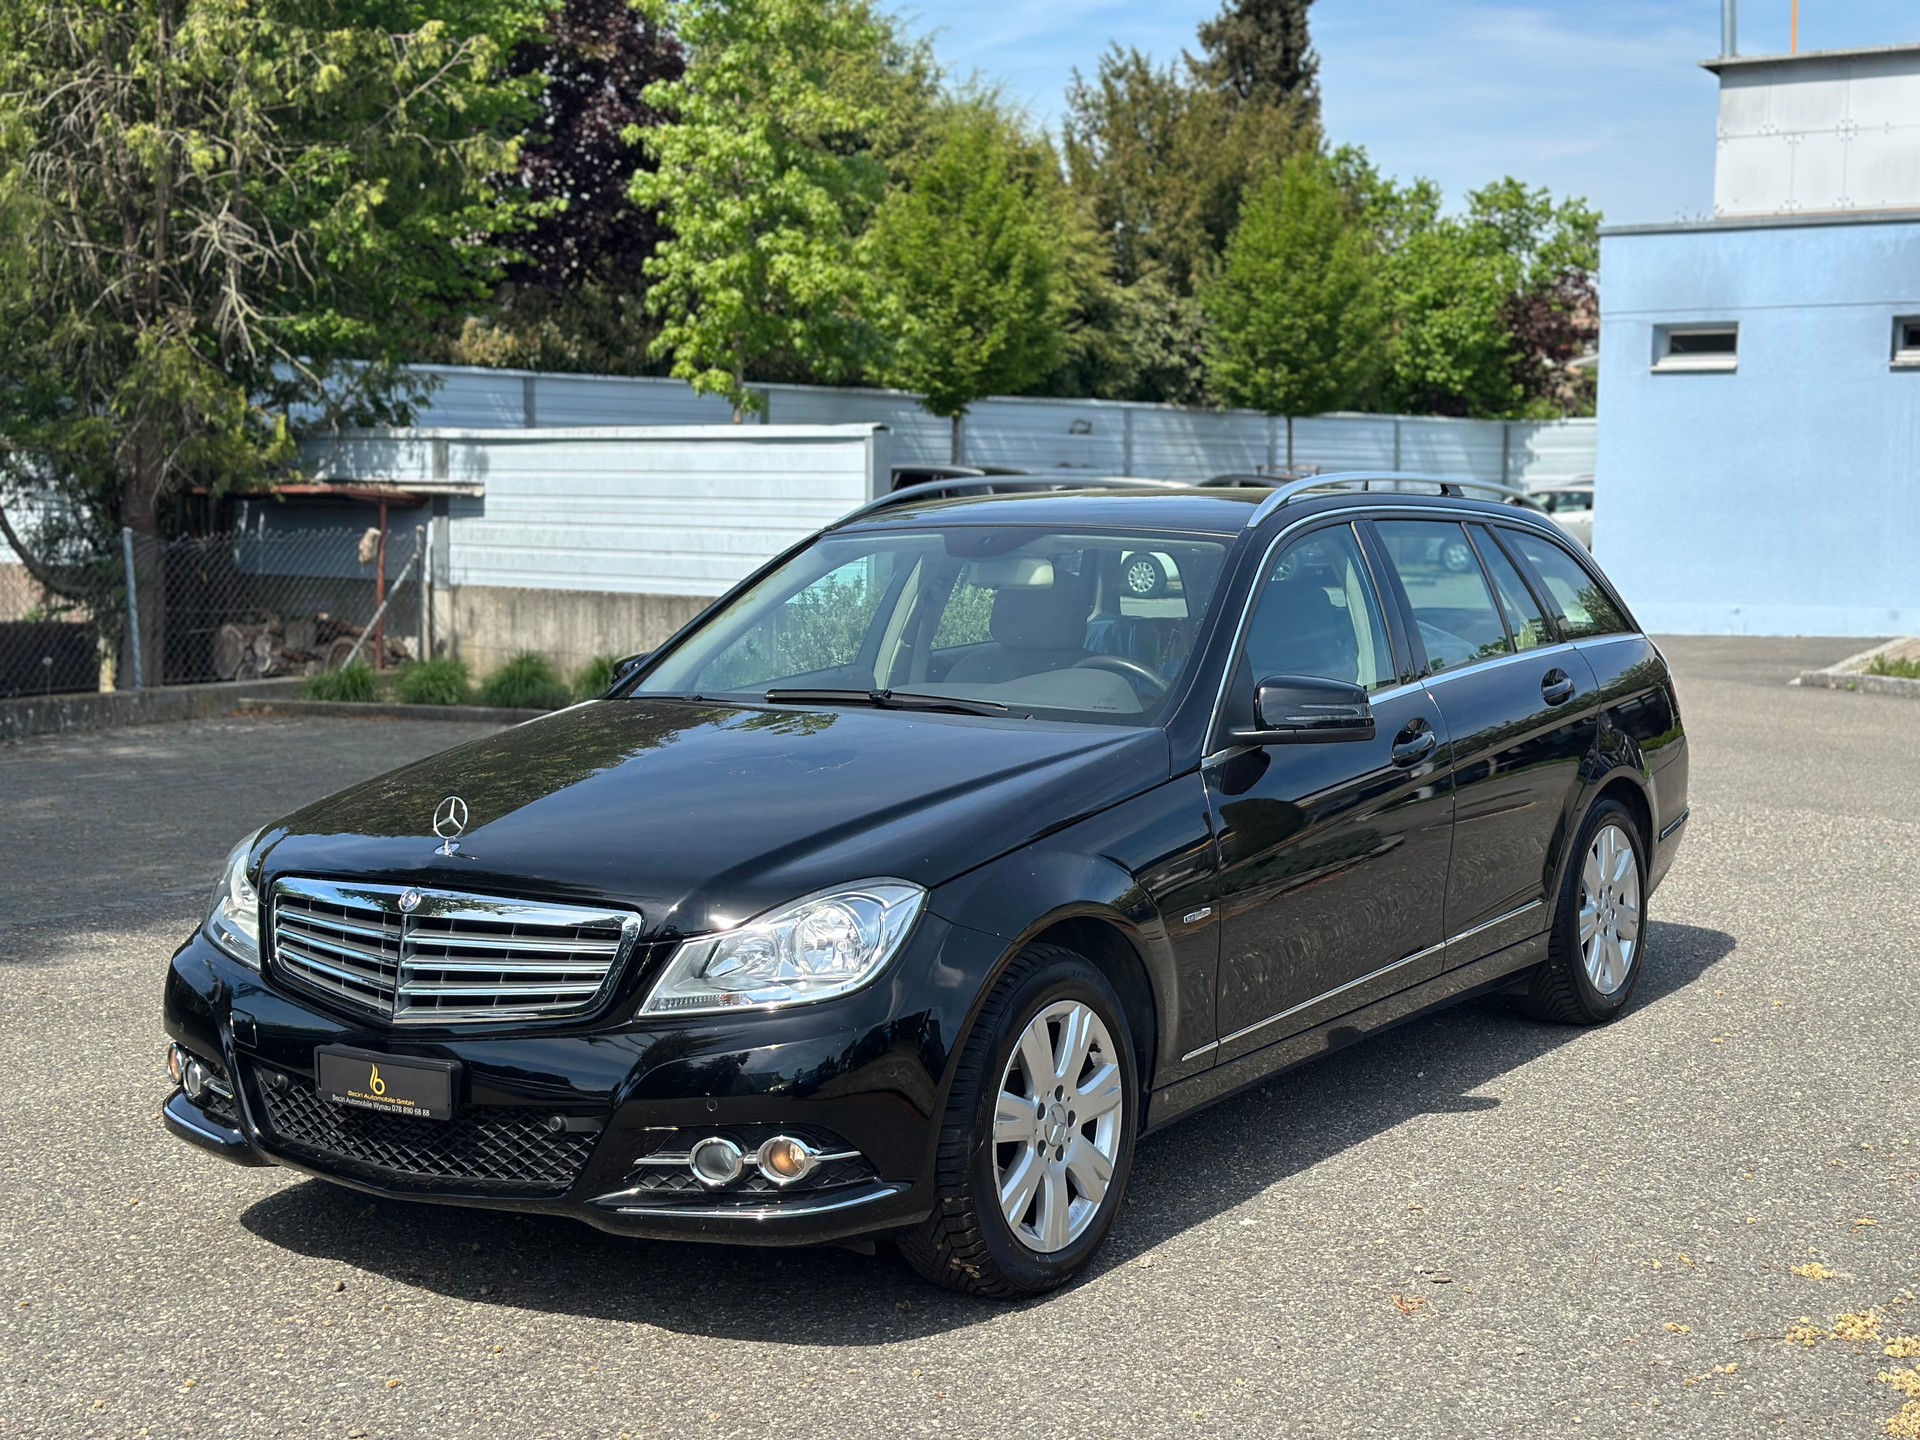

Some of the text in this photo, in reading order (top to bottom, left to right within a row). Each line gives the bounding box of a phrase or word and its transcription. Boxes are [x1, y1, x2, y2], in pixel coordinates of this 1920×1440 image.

[346, 1097, 373, 1108] Automobile
[373, 1101, 391, 1111] Wynau
[391, 1104, 403, 1113] 078
[403, 1106, 414, 1115] 890
[414, 1108, 422, 1116] 68
[422, 1109, 430, 1117] 88
[363, 1093, 396, 1103] Automobile
[396, 1098, 415, 1106] GmbH
